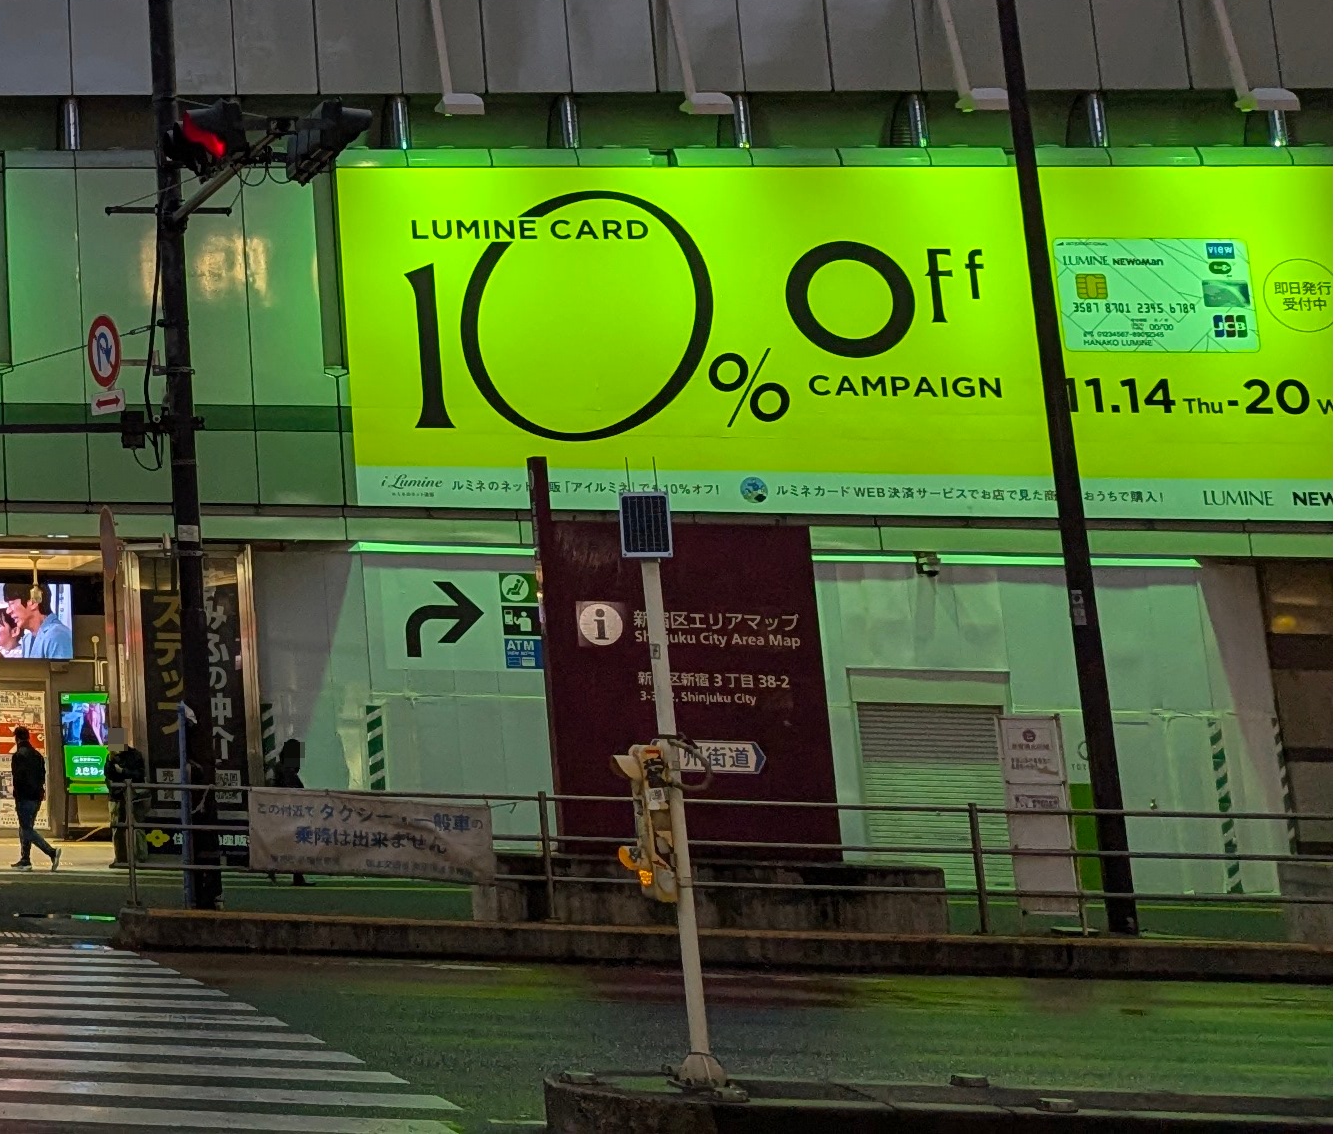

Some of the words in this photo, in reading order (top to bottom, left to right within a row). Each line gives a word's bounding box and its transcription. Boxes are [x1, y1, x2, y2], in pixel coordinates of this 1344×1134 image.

[410, 219, 538, 241] LUMINE
[549, 218, 650, 241] CARD
[1062, 255, 1110, 265] LUMINE
[1274, 281, 1331, 296] 即日発行
[1073, 302, 1100, 313] 3587
[1137, 303, 1164, 314] 2345
[1282, 297, 1327, 312] 受付中
[1083, 339, 1120, 347] HANAKO
[808, 373, 1003, 399] CAMPAIGN
[1203, 490, 1274, 507] LUMINE
[633, 610, 799, 631] 新区エリアマップ
[506, 640, 535, 651] ATM
[635, 630, 697, 646] Shjuku
[700, 632, 727, 647] City
[732, 633, 765, 646] Area
[769, 635, 801, 650] Map
[681, 692, 732, 705] Shinjuku
[735, 693, 757, 706] City
[683, 746, 750, 768] 州街道
[294, 826, 447, 854] 乗降は出来ません
